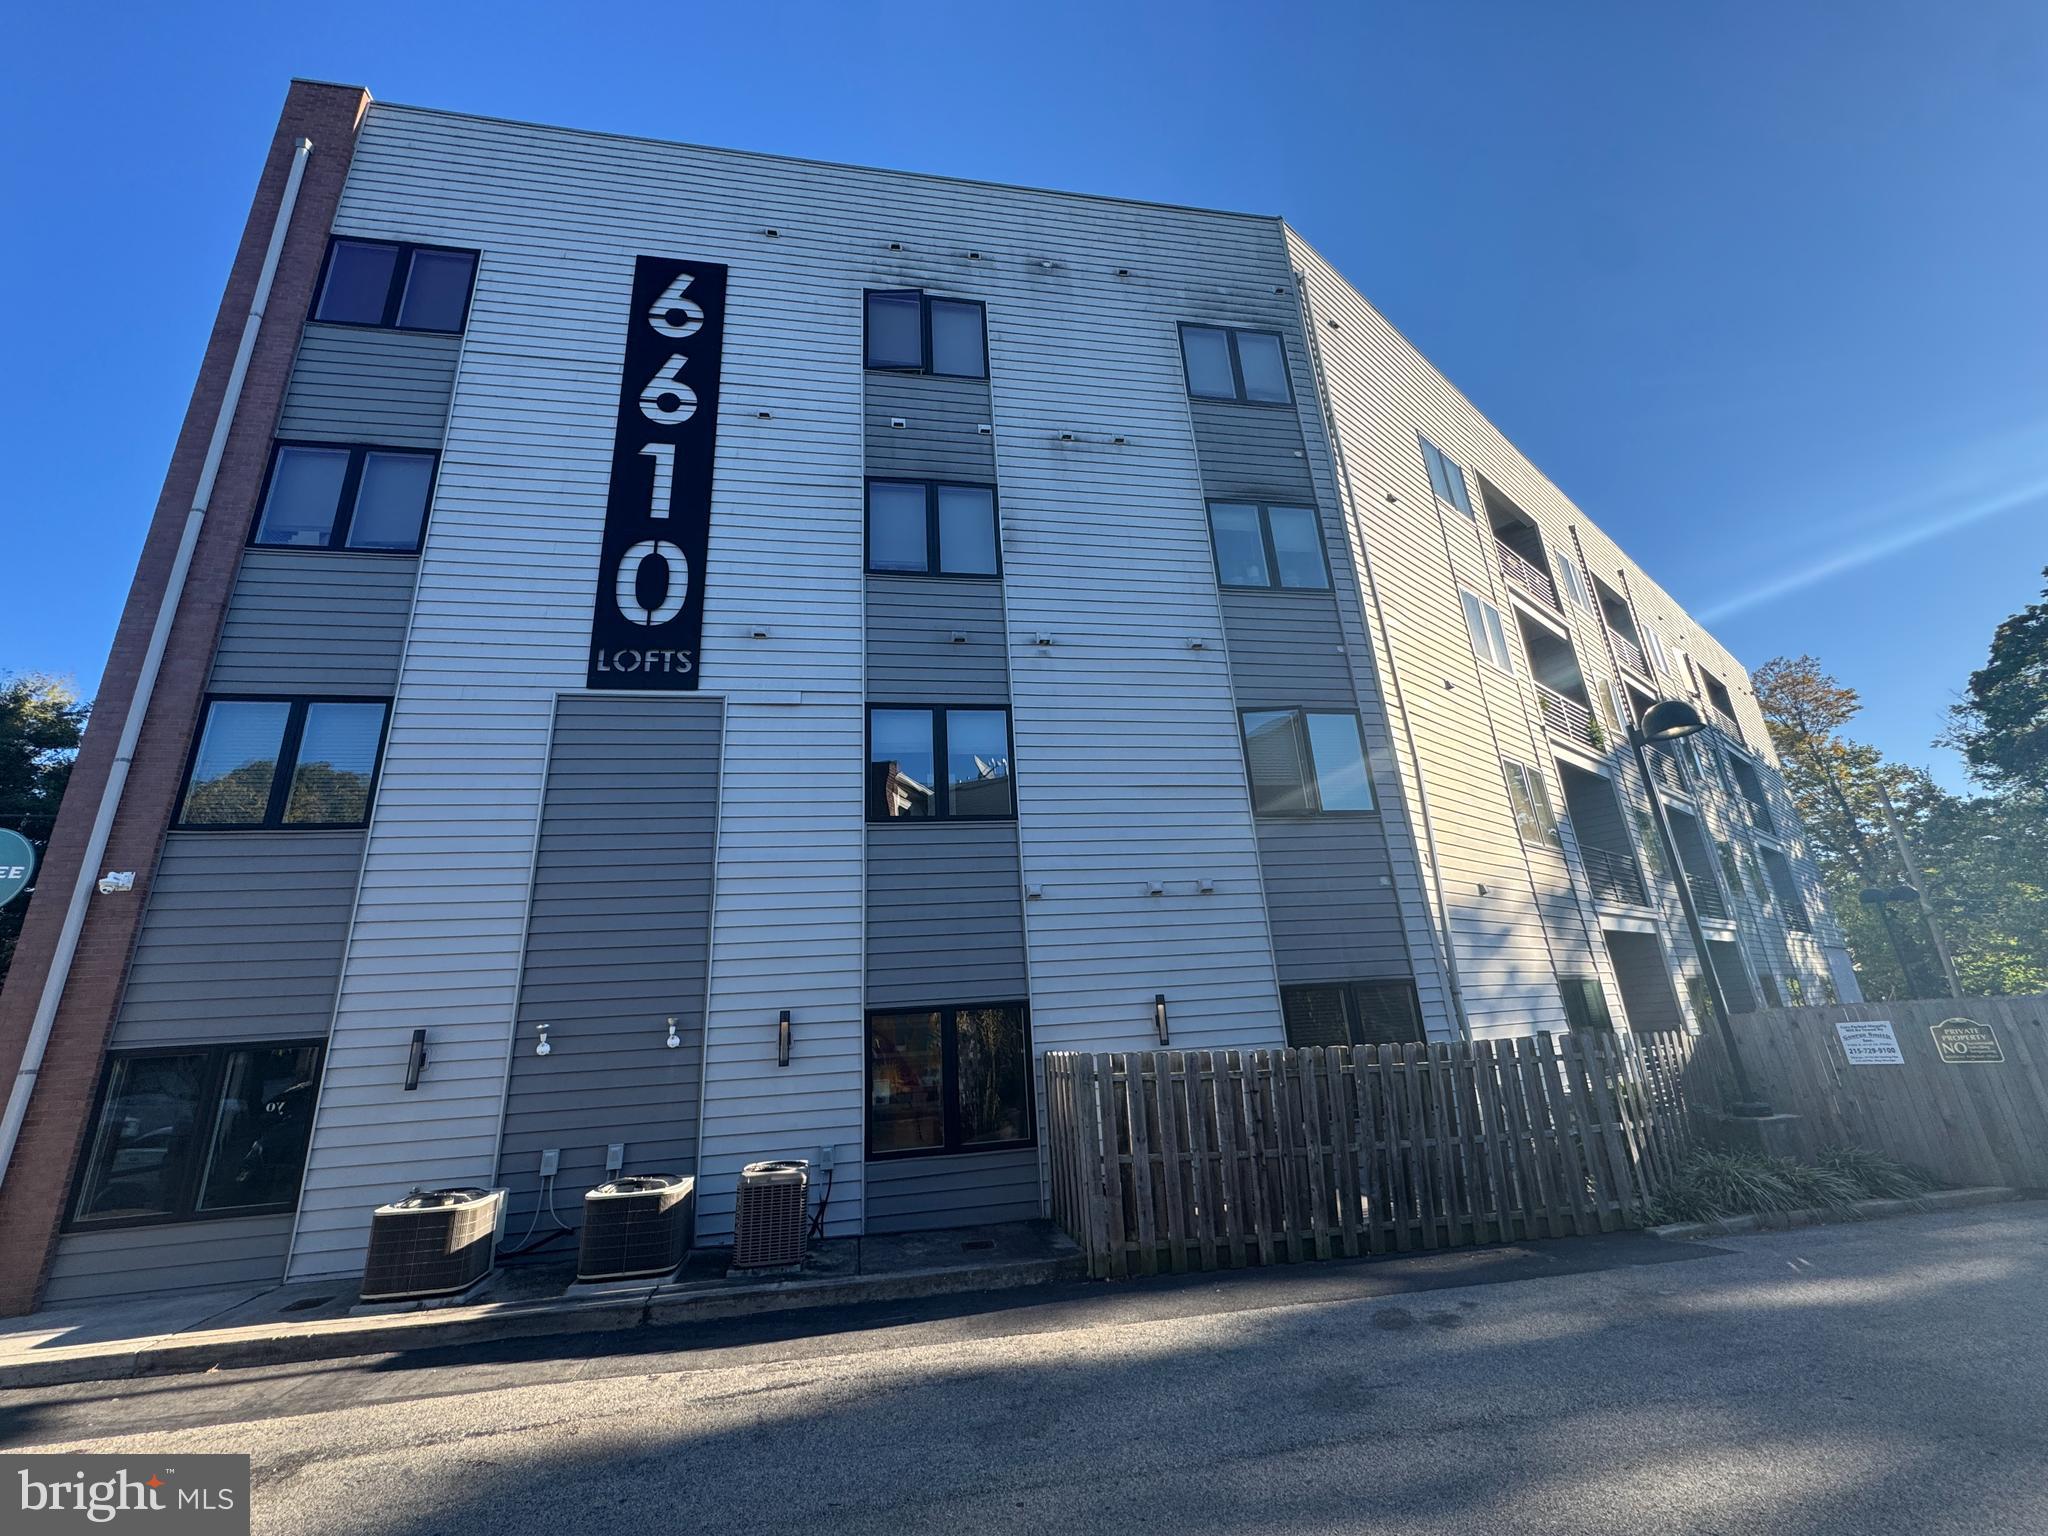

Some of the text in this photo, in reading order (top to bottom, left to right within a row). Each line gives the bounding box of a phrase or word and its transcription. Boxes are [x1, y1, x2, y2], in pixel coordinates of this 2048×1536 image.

[615, 273, 704, 626] 6610
[597, 648, 692, 673] LOFTS
[1941, 1042, 1968, 1054] NO
